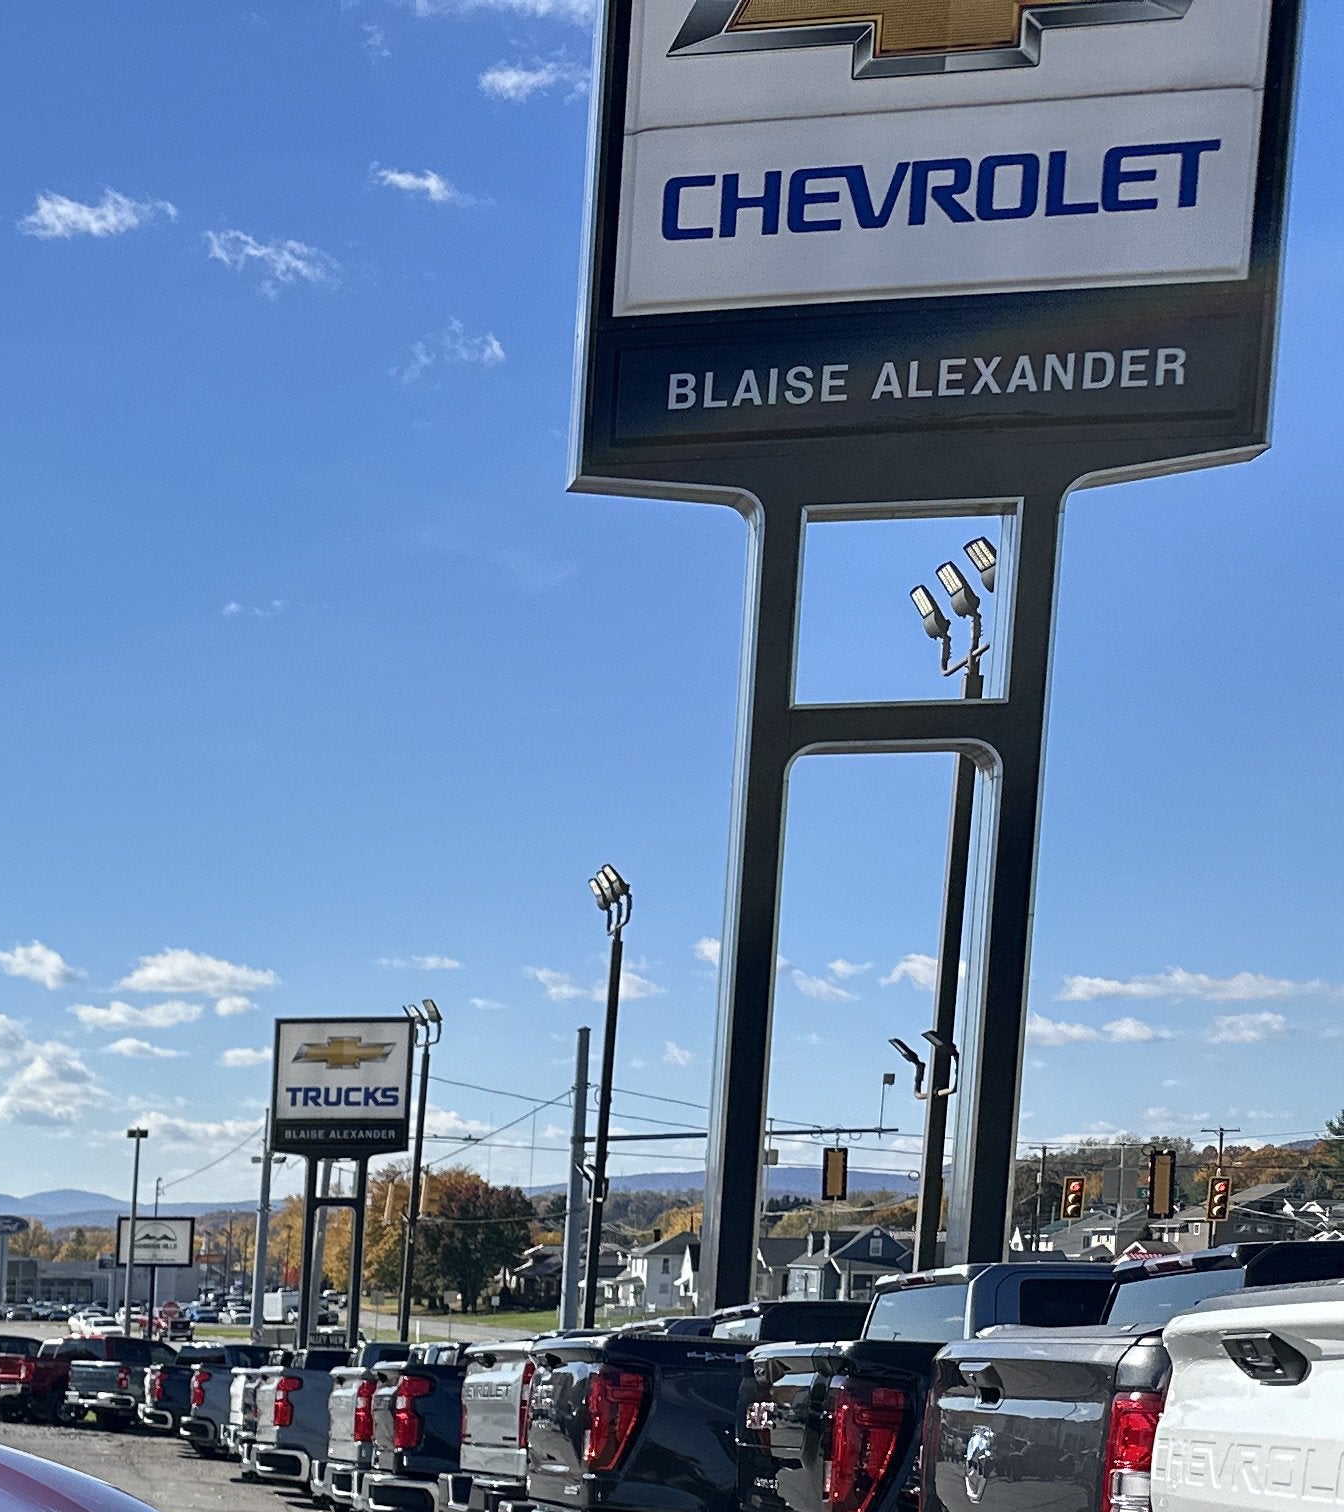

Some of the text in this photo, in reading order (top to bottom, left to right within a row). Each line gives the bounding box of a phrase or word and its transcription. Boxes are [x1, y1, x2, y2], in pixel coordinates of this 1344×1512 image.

[661, 139, 1221, 242] CHEVROLET
[667, 348, 1188, 411] BLAISE ALEXANDER
[285, 1086, 400, 1107] TRUCKS
[284, 1129, 396, 1140] BLAISE ALEXANDER
[1152, 1437, 1344, 1505] CHEVROL
